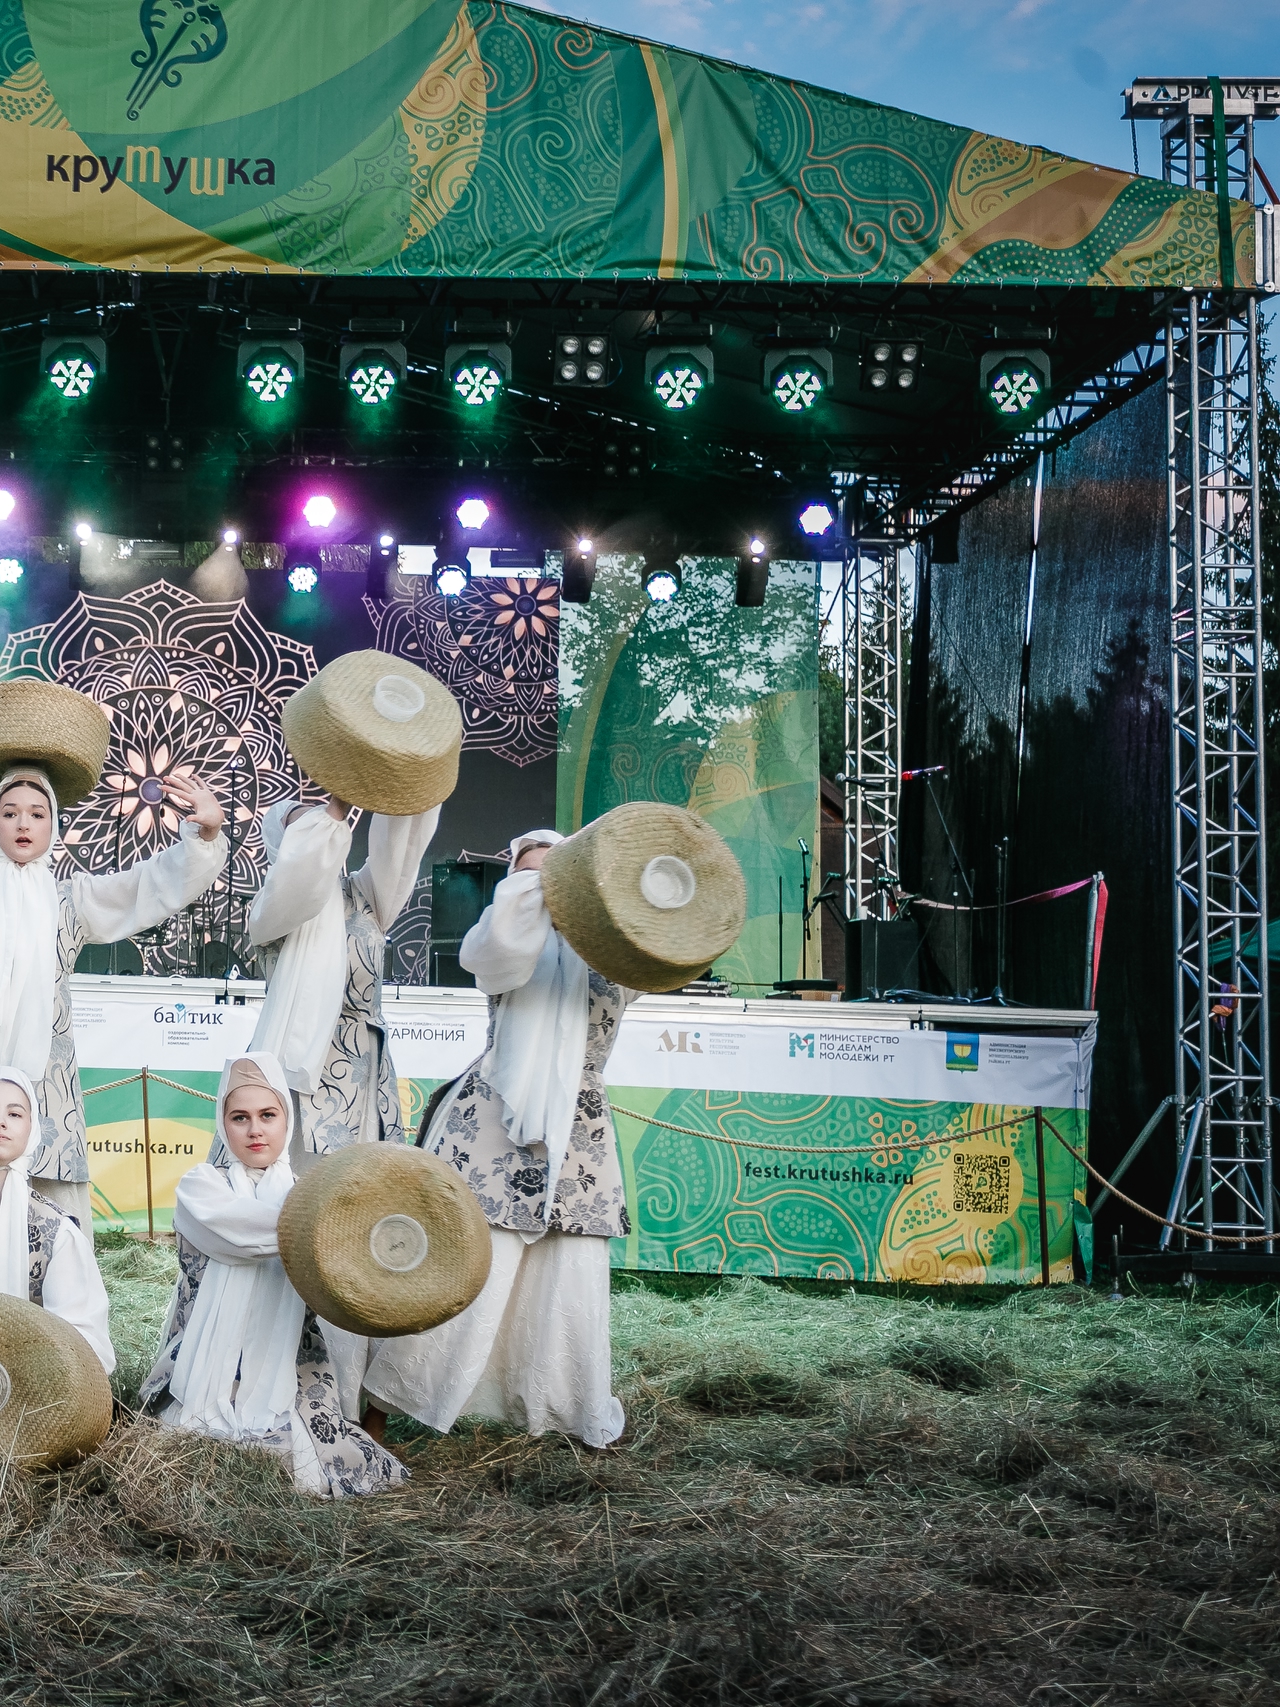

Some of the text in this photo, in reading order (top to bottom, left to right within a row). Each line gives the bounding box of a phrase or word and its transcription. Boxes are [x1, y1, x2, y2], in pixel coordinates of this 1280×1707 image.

[46, 145, 277, 196] крутушка
[153, 1003, 224, 1025] байтик
[819, 1033, 900, 1045] МИНИСТЕРСТВО
[819, 1042, 872, 1053] ПО ДЕЛАМ
[819, 1052, 895, 1063] МОЛОДЕЖИ РТ
[744, 1161, 915, 1186] fest.krutushka.ru
